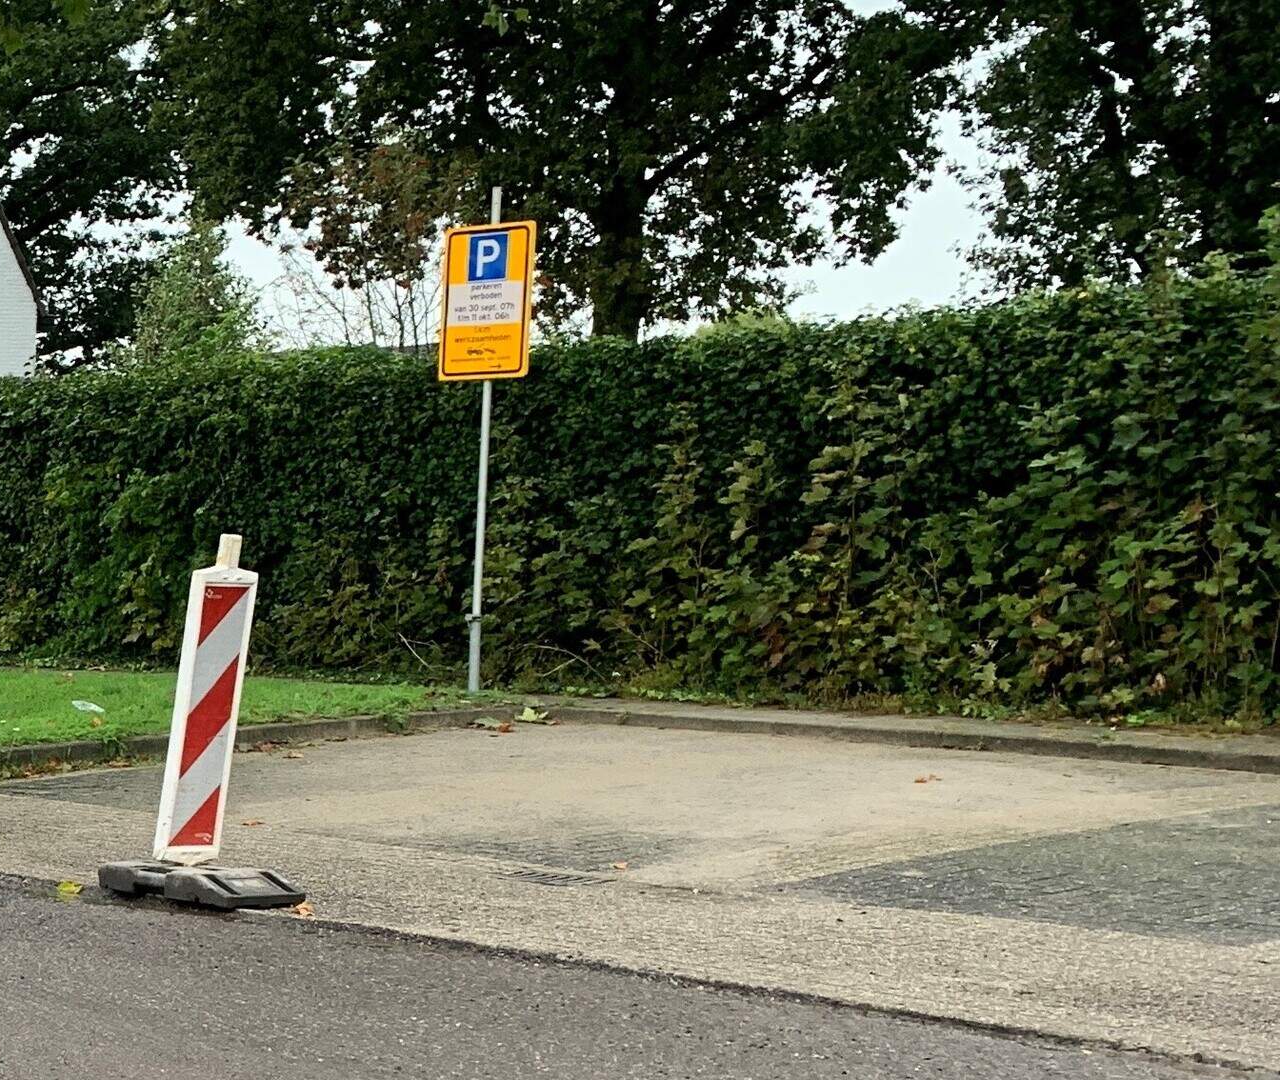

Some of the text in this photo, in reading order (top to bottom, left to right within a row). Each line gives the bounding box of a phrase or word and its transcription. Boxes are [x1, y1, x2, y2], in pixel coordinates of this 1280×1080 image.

[476, 239, 501, 278] P
[471, 283, 503, 292] parkeren
[470, 292, 503, 300] verboden
[468, 304, 479, 312] 30
